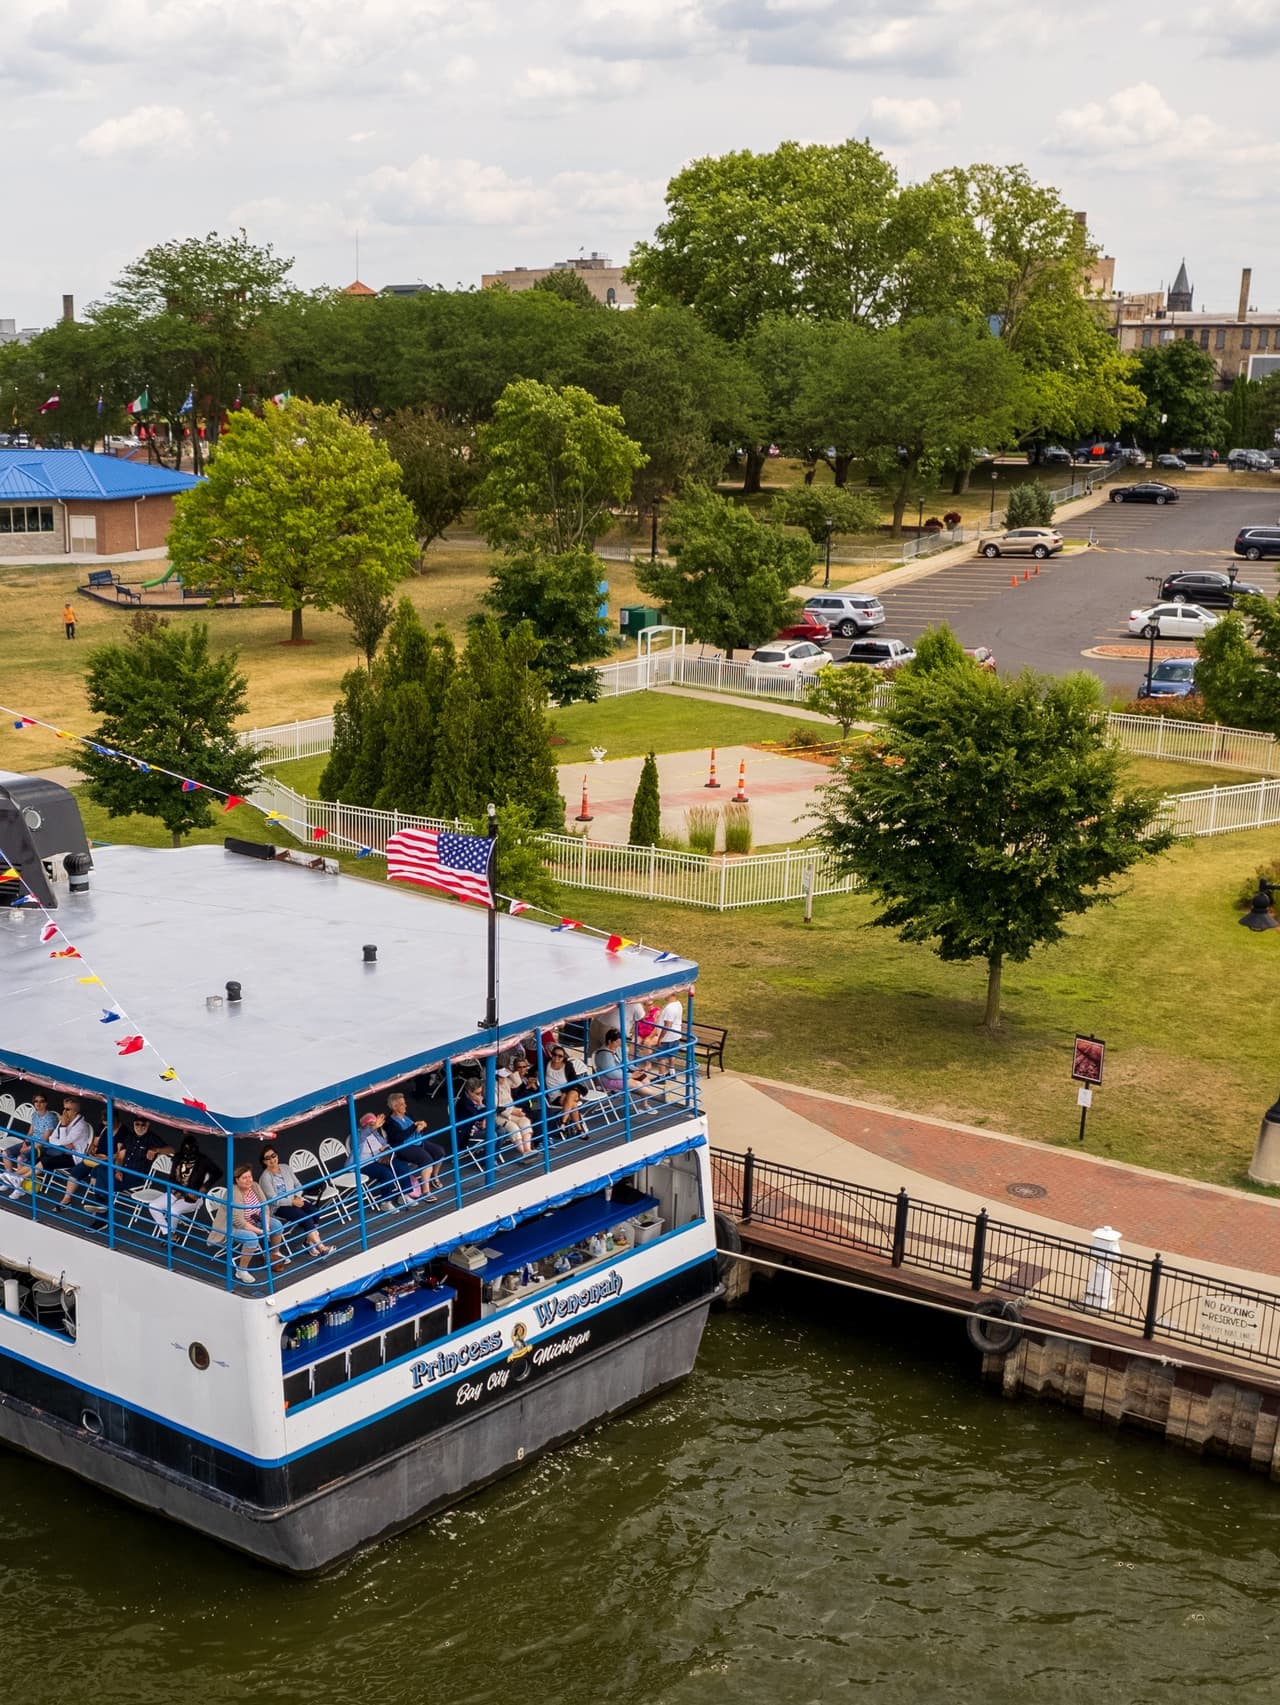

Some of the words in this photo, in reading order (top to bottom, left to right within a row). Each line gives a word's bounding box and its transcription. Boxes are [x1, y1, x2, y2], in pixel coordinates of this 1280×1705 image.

[409, 1329, 503, 1389] Princess
[533, 1269, 623, 1328] Wenonah
[1204, 1299, 1216, 1309] NO
[1220, 1303, 1256, 1319] DOCKING
[1208, 1312, 1248, 1328] RESERVED
[456, 1382, 483, 1406] Bay
[487, 1368, 510, 1392] City
[532, 1329, 591, 1365] Michigan
